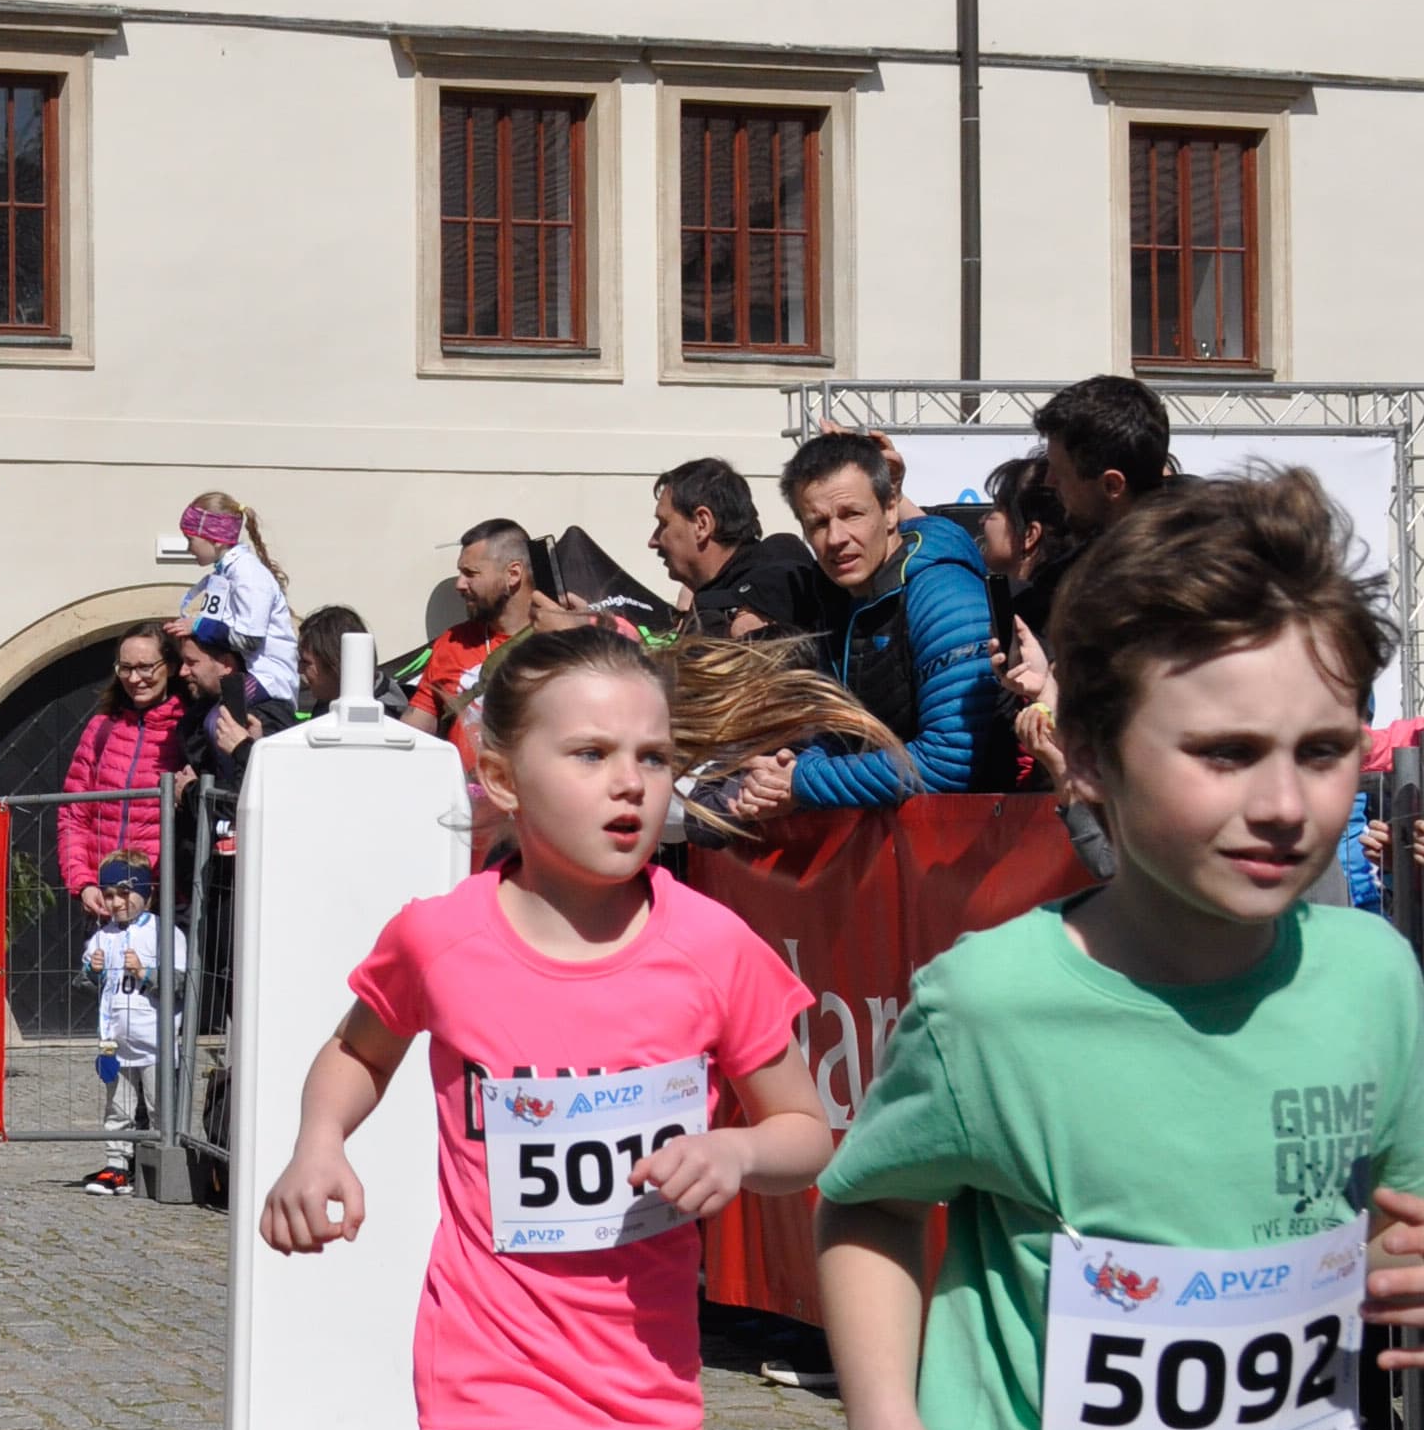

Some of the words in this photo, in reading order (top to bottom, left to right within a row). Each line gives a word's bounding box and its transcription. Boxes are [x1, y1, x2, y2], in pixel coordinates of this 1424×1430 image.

[594, 1084, 644, 1105] PVZP
[1272, 1082, 1376, 1138] GAME
[527, 1229, 565, 1242] PVZP
[1221, 1264, 1292, 1293] PVZP
[1080, 1314, 1341, 1430] 5092
